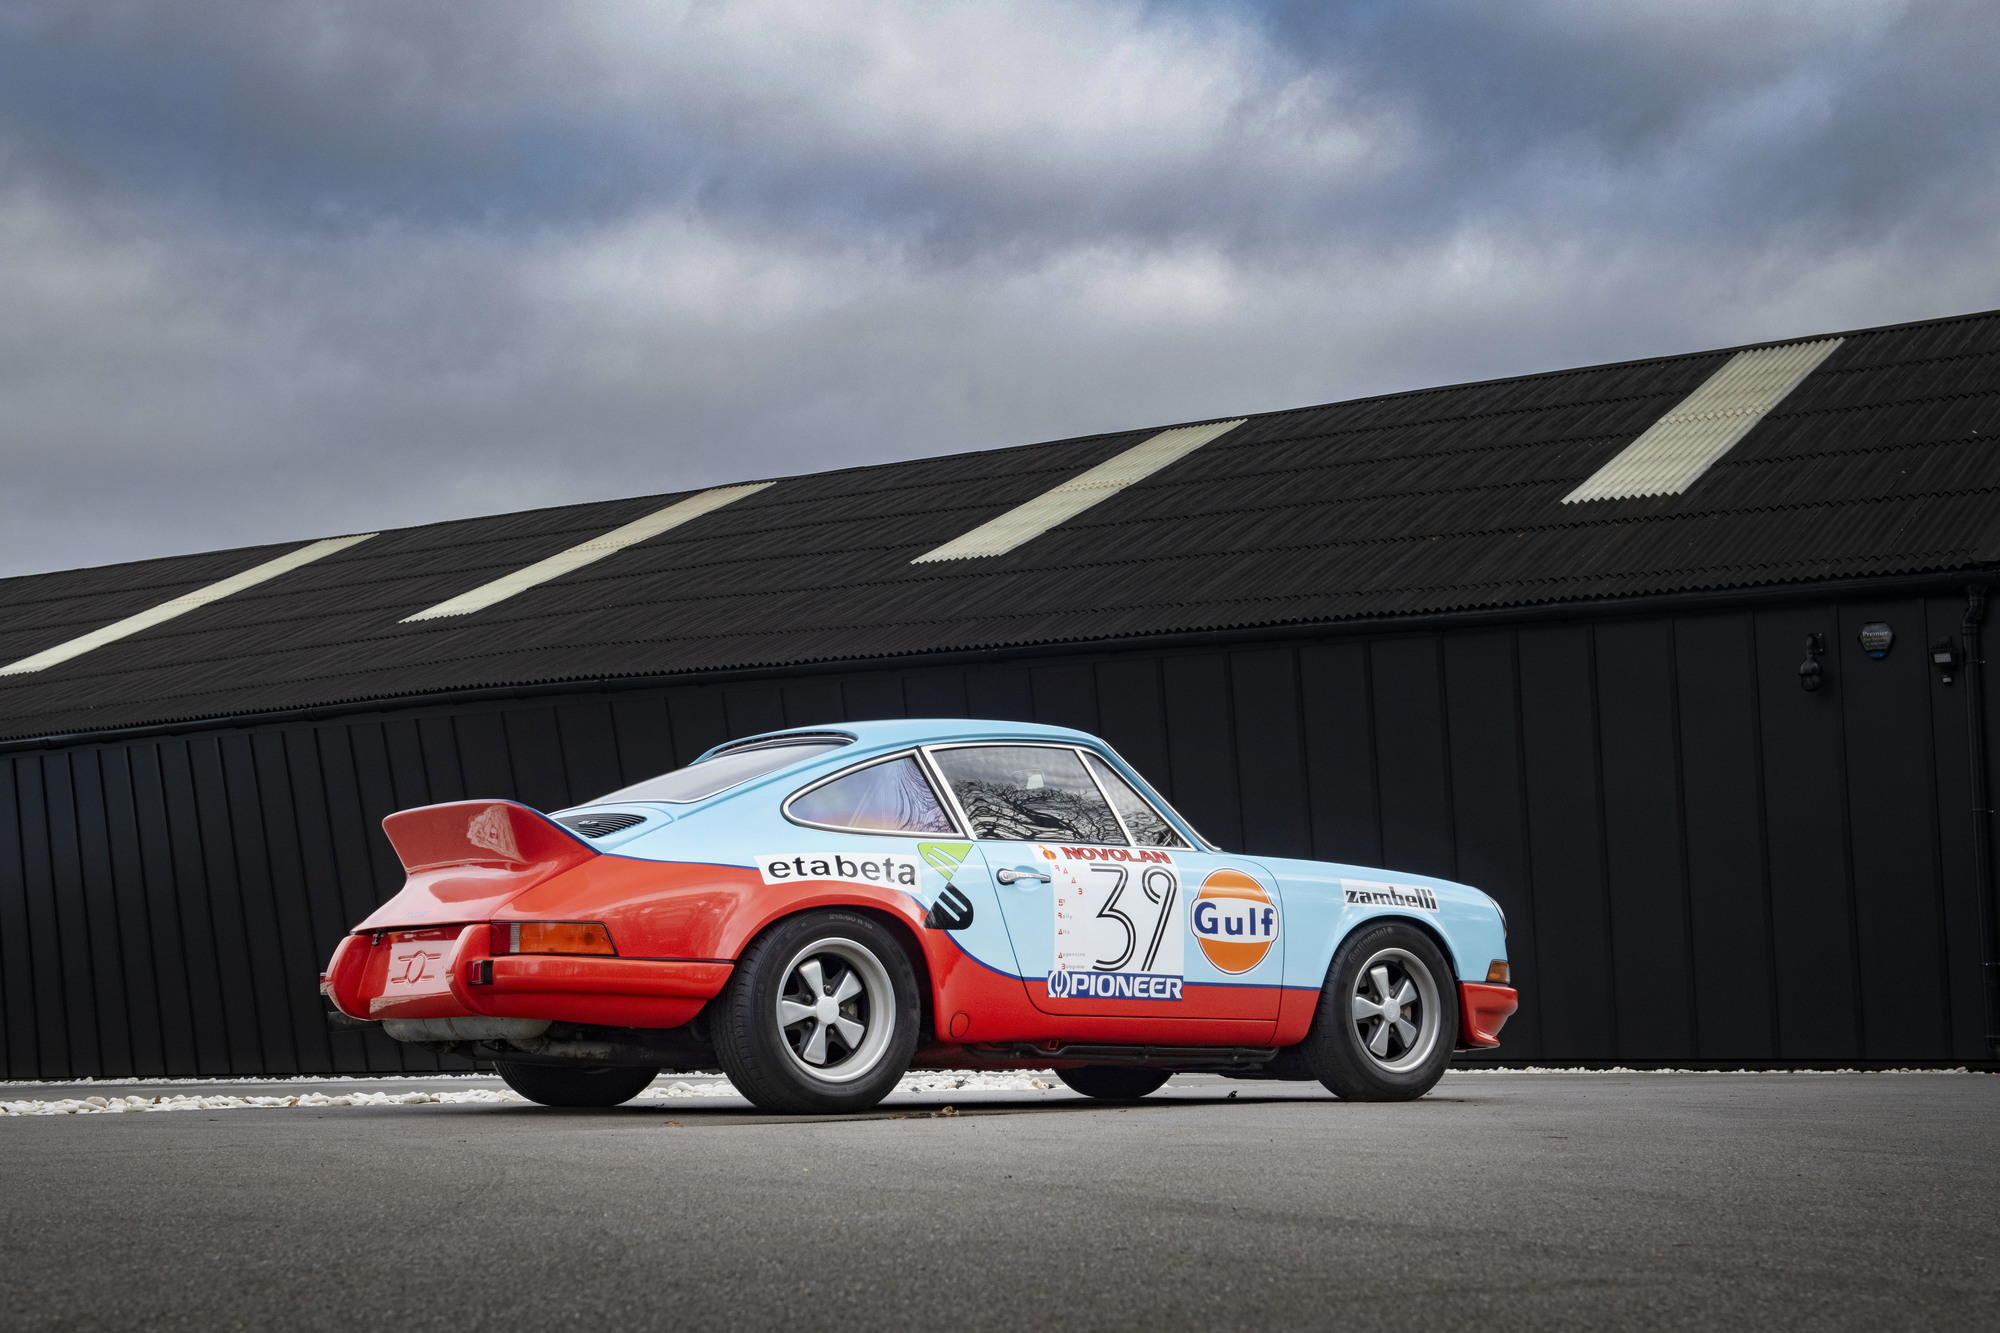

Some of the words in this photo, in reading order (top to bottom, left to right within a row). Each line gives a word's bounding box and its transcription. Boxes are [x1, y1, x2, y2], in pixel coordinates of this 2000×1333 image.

[1060, 847, 1172, 864] NOVOLAN
[768, 855, 915, 885] etabeta
[1345, 886, 1437, 909] zambelli
[1089, 863, 1178, 972] 39
[1194, 901, 1274, 936] Gulf
[1071, 974, 1182, 999] PIONEER
